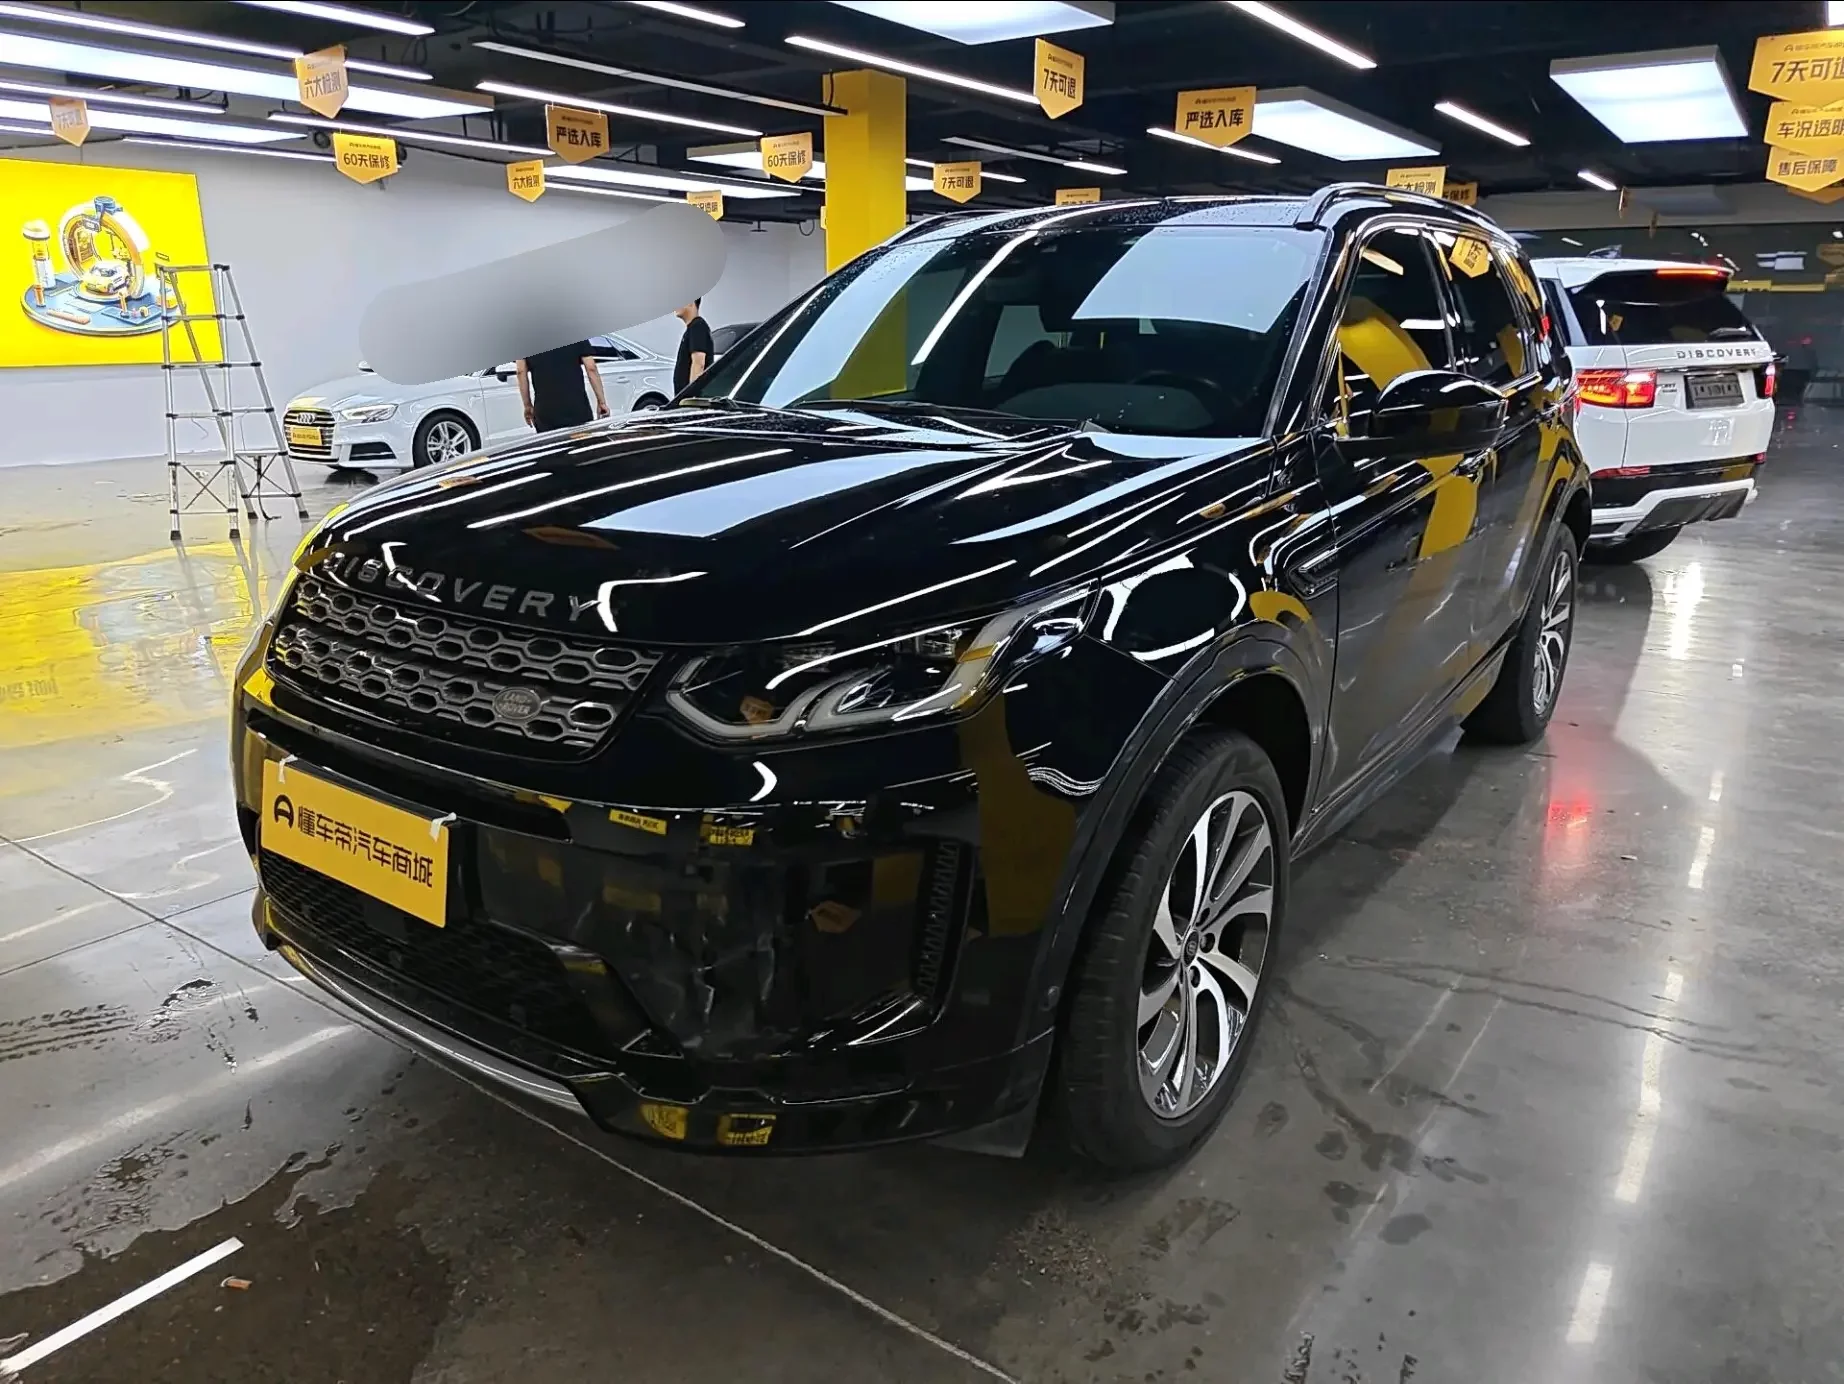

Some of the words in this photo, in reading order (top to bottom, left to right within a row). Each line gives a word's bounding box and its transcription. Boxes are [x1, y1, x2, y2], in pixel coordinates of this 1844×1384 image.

[304, 70, 342, 99] 六大检测
[1043, 68, 1077, 99] 7天可退
[1185, 108, 1244, 130] 严选入库
[556, 126, 602, 149] 严选入库
[343, 152, 390, 170] 60天保修
[767, 150, 806, 168] 60天保修
[1777, 159, 1838, 176] 售后保障
[513, 175, 540, 190] 六大检测
[942, 175, 974, 189] 7天可退
[323, 552, 600, 622] DISCOVERY
[298, 806, 434, 888] 懂车帝汽车商城
